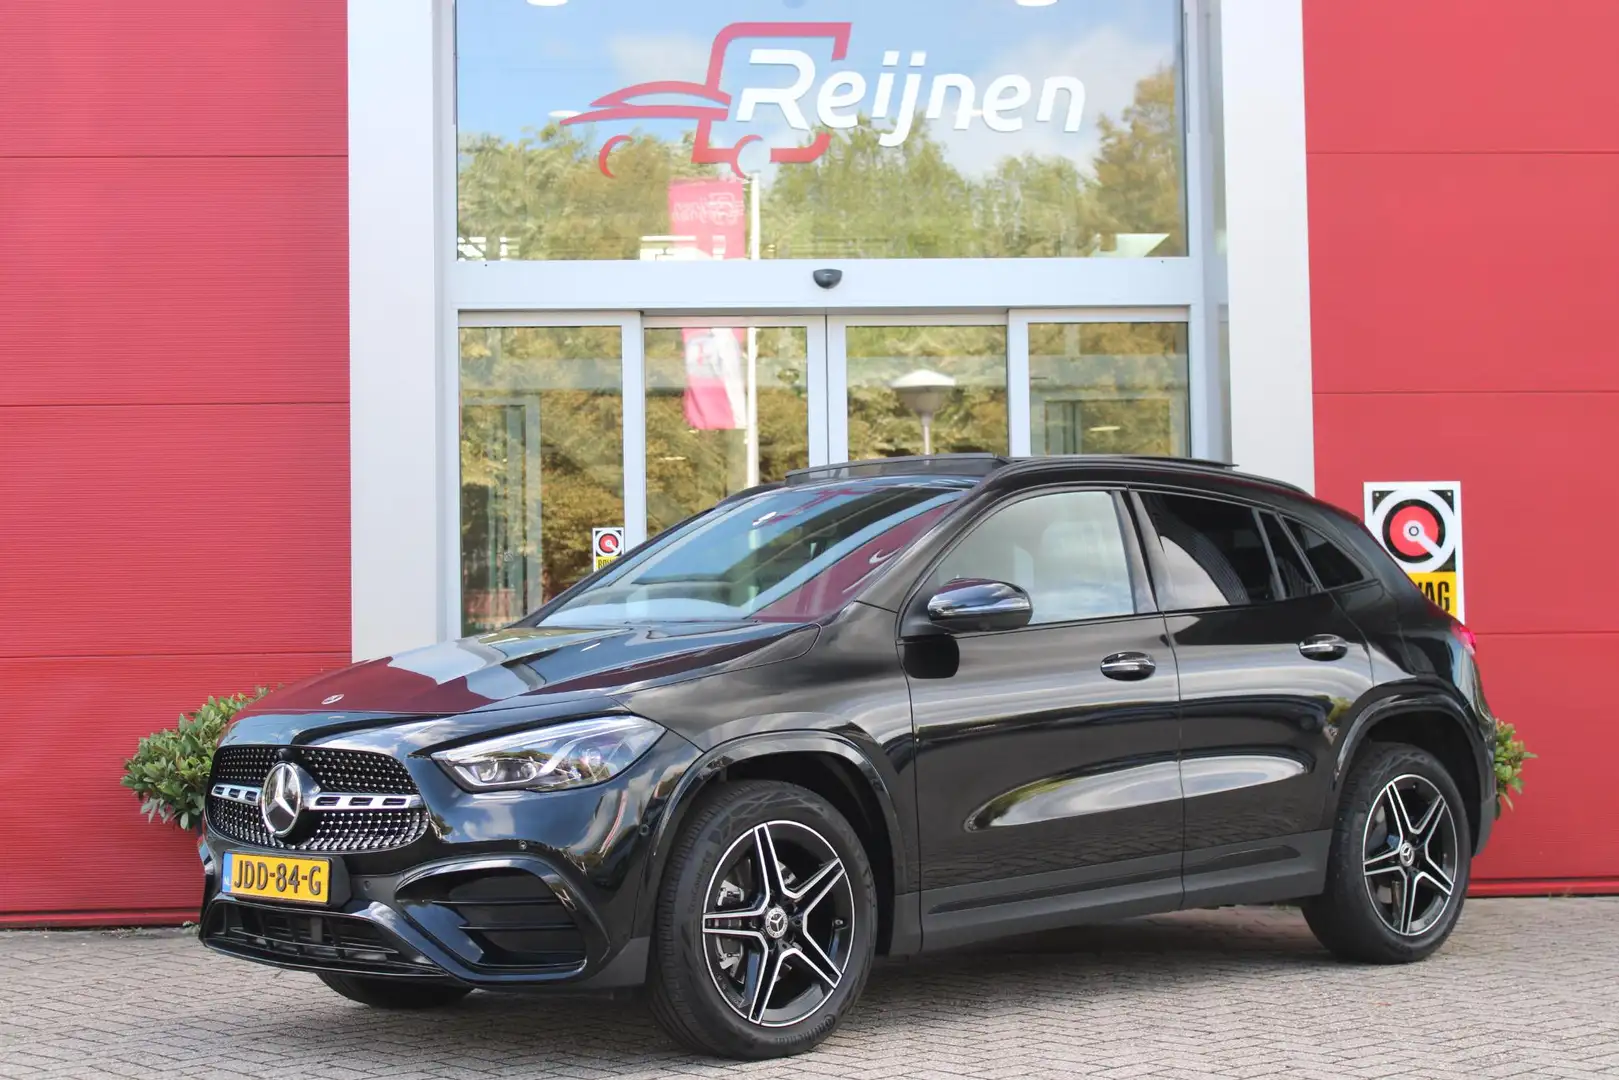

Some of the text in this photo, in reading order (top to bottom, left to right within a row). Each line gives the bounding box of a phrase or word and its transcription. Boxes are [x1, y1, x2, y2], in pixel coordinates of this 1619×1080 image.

[735, 49, 1085, 147] Reijnen
[1418, 581, 1450, 612] AG
[234, 860, 321, 895] JDD-84-G
